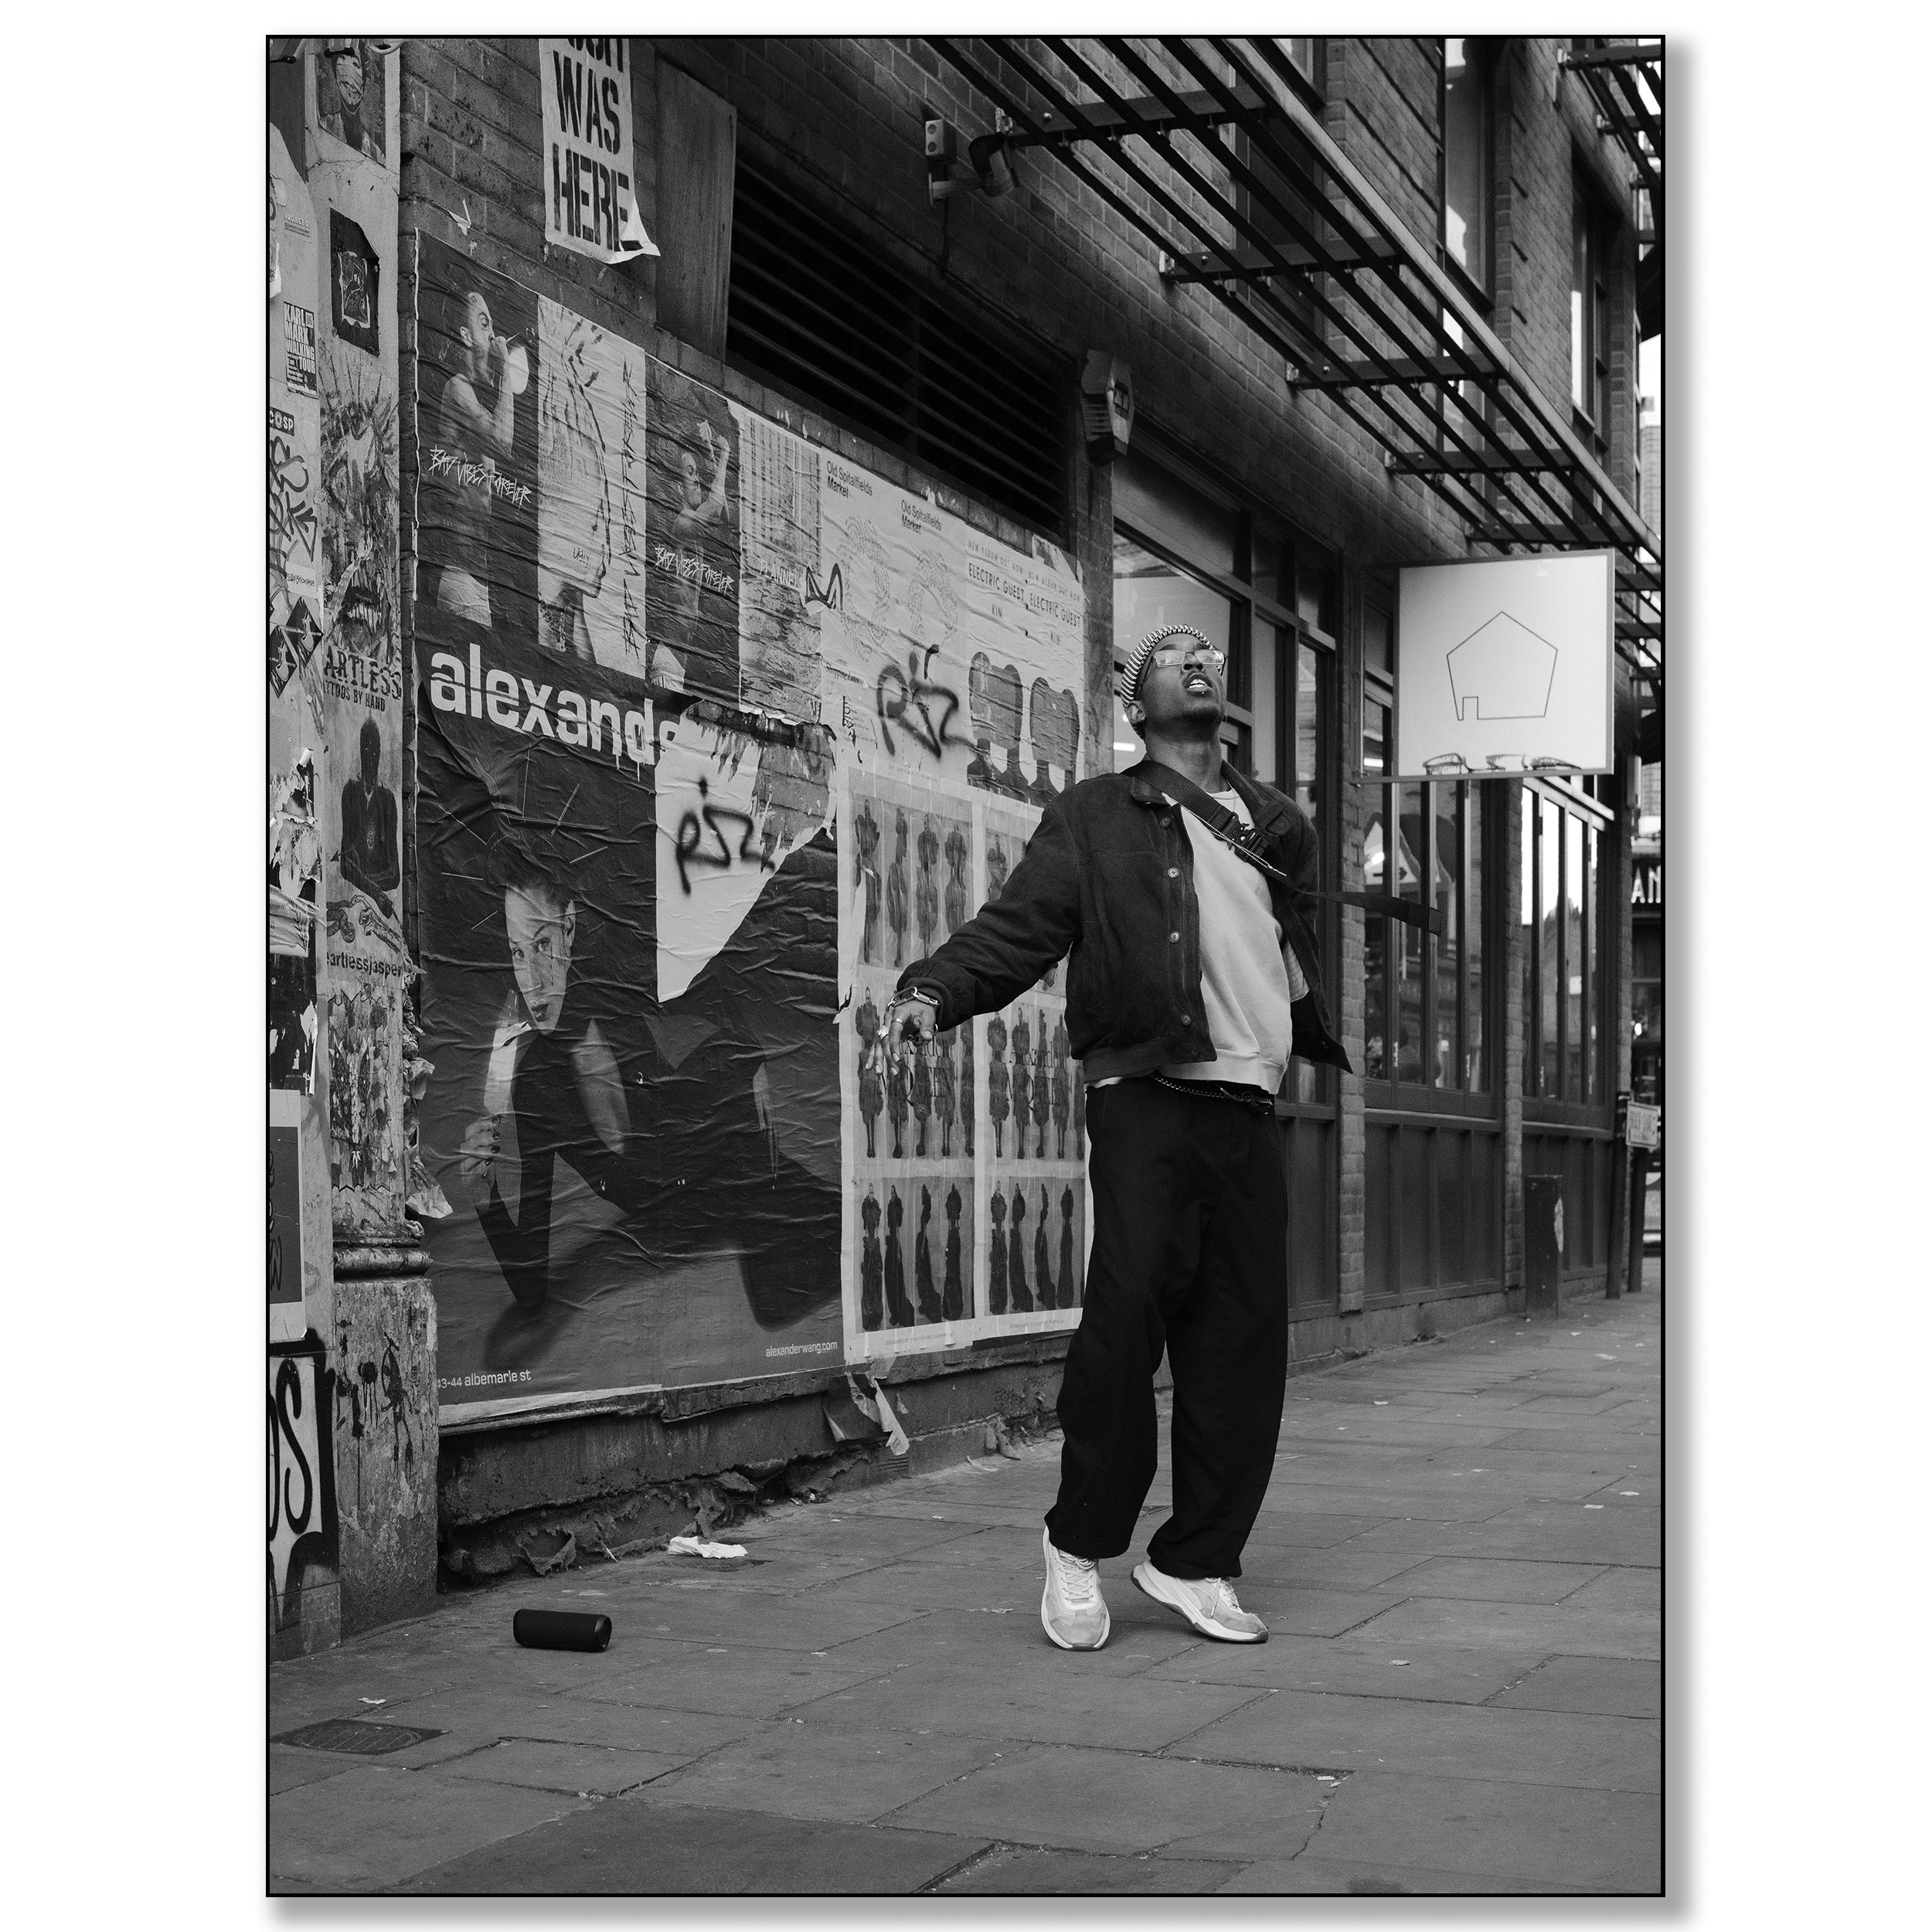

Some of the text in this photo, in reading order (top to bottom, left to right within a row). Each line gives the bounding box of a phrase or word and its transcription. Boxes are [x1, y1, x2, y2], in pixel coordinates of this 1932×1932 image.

[553, 49, 621, 155] WAS
[553, 142, 643, 252] HERE
[284, 303, 306, 328] KARL
[285, 320, 309, 346] MARX
[286, 338, 315, 361] WALKING
[298, 355, 316, 374] TOUR
[428, 444, 532, 511] BAD VIBES FOREVER
[826, 461, 872, 496] Old Spitalfields
[827, 475, 849, 498] Market
[901, 499, 942, 532] Old Spitalfields
[901, 514, 922, 535] Market
[655, 543, 735, 594] BAD VIBES FOREVER
[968, 563, 1025, 602] ELECTRIC GUEST
[992, 604, 1003, 619] KIN
[1029, 593, 1080, 629] ELECTRIC GUEST
[1050, 631, 1061, 646] KIN
[324, 645, 402, 701] ARTLESS
[353, 689, 363, 705] BY
[366, 692, 386, 712] HAND
[765, 1342, 838, 1357] alexanderwang.com
[464, 1369, 518, 1386] albemarle
[519, 1369, 532, 1382] st
